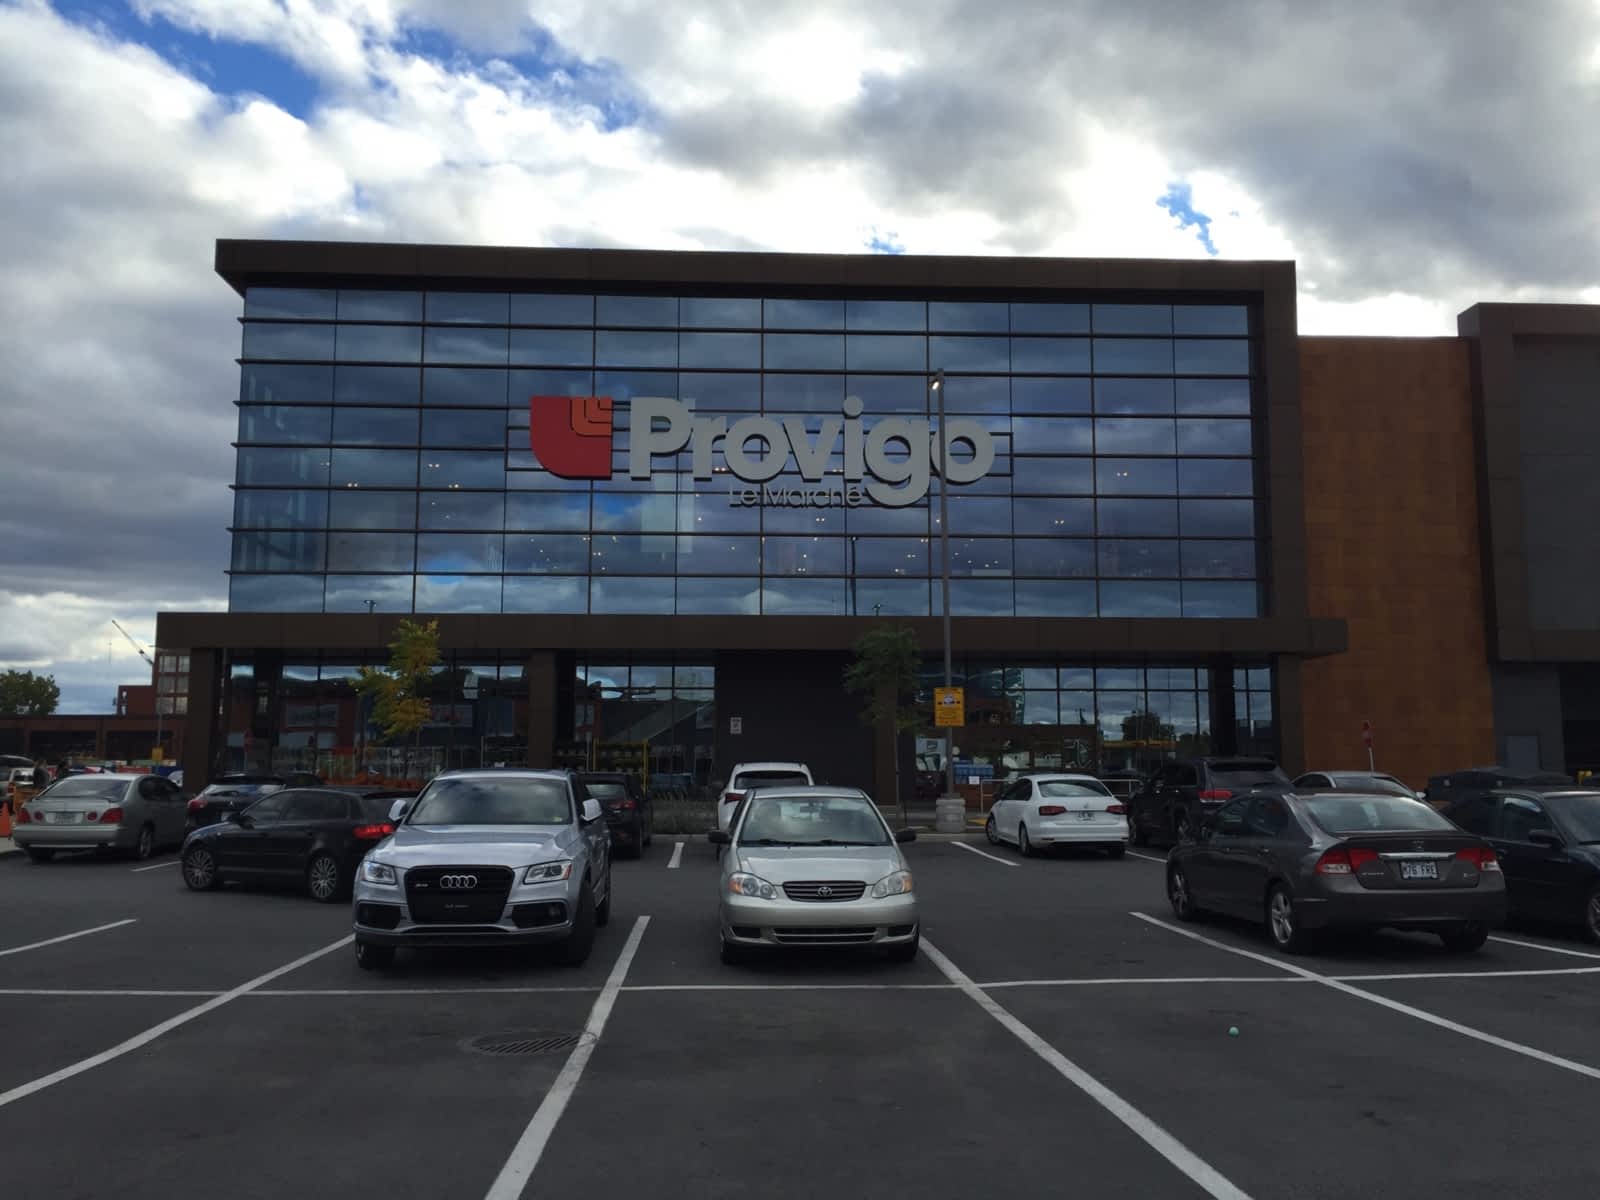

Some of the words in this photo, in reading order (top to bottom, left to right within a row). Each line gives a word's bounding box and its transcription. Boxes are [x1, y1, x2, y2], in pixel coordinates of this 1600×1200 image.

[630, 397, 995, 507] Provigo
[730, 482, 758, 507] Le
[763, 484, 862, 507] Marché
